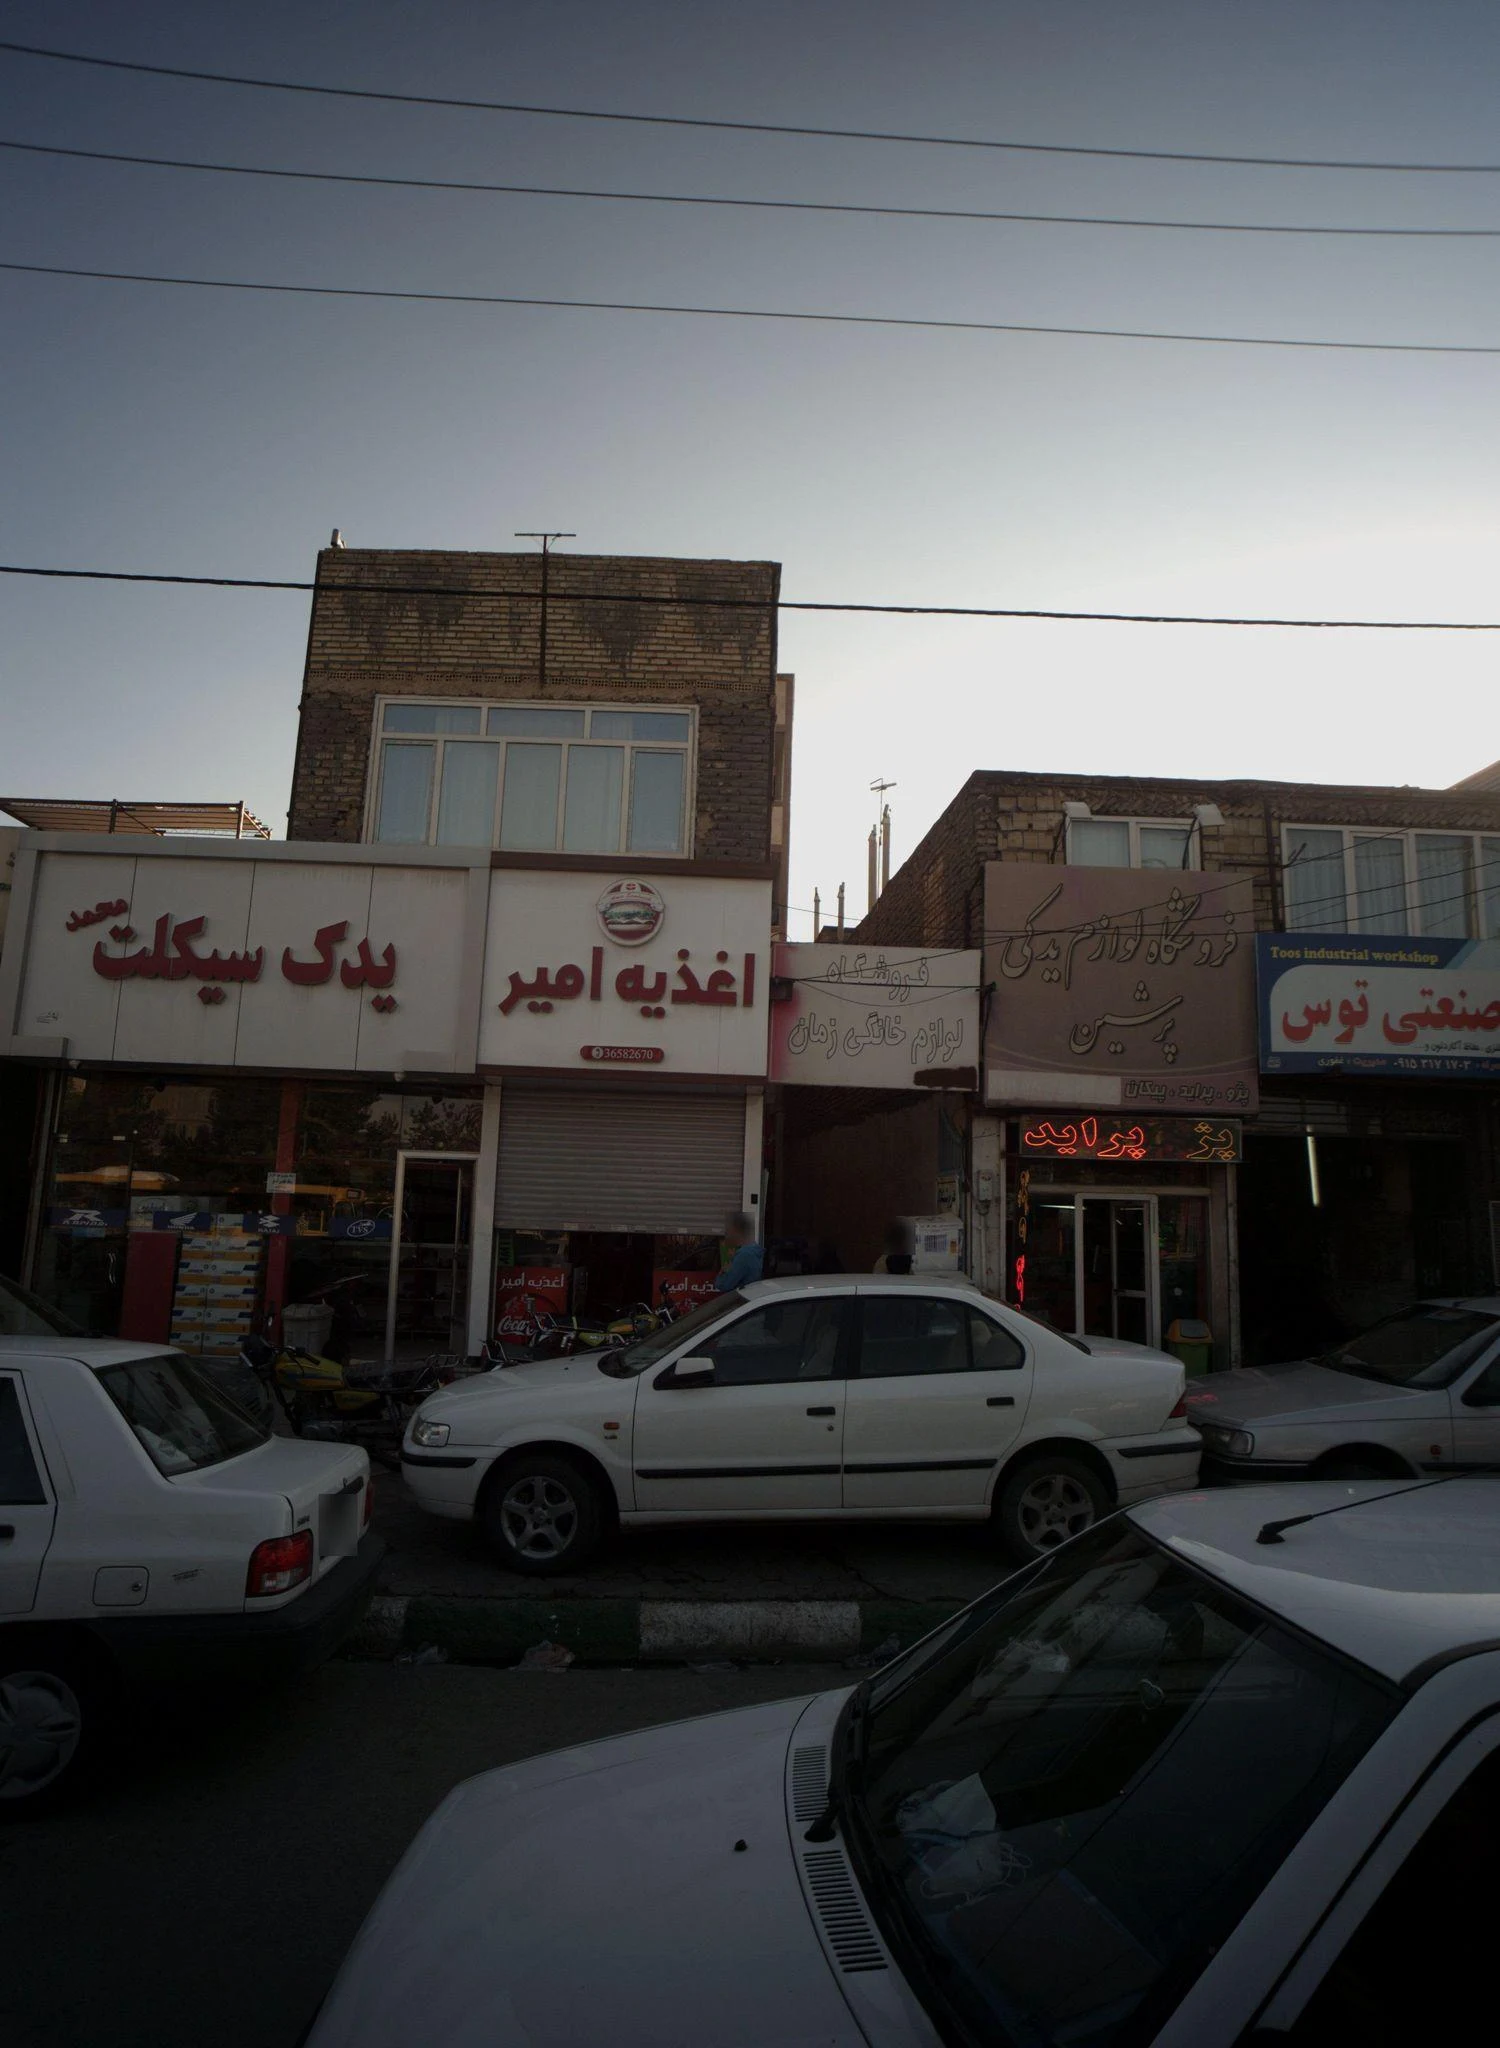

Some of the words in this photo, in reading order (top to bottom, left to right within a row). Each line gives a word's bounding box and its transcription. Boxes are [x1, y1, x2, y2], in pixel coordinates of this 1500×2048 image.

[66, 899, 129, 933] محمد
[1001, 883, 1063, 982] یدکی
[1146, 887, 1237, 967] فروشگاه
[93, 912, 264, 1004] سیکلت
[281, 921, 397, 1013] یدک
[1065, 910, 1143, 990] لوازم
[1270, 945, 1300, 959] Toos
[1304, 948, 1369, 961] industrial
[1372, 950, 1440, 964] workshop
[499, 946, 604, 1016] امیر
[615, 949, 755, 1018] اغذیه
[827, 953, 930, 1002] فروشگاه
[788, 1013, 837, 1059] زمان
[843, 1012, 906, 1056] خانگی
[1069, 981, 1184, 1064] پرشین
[1282, 980, 1369, 1044] توس
[603, 1048, 653, 1060] 36582670
[911, 1018, 963, 1064] لوازم
[1125, 1080, 1167, 1104] پیکان
[1180, 1083, 1214, 1105] پراید
[499, 1271, 525, 1291] امیر
